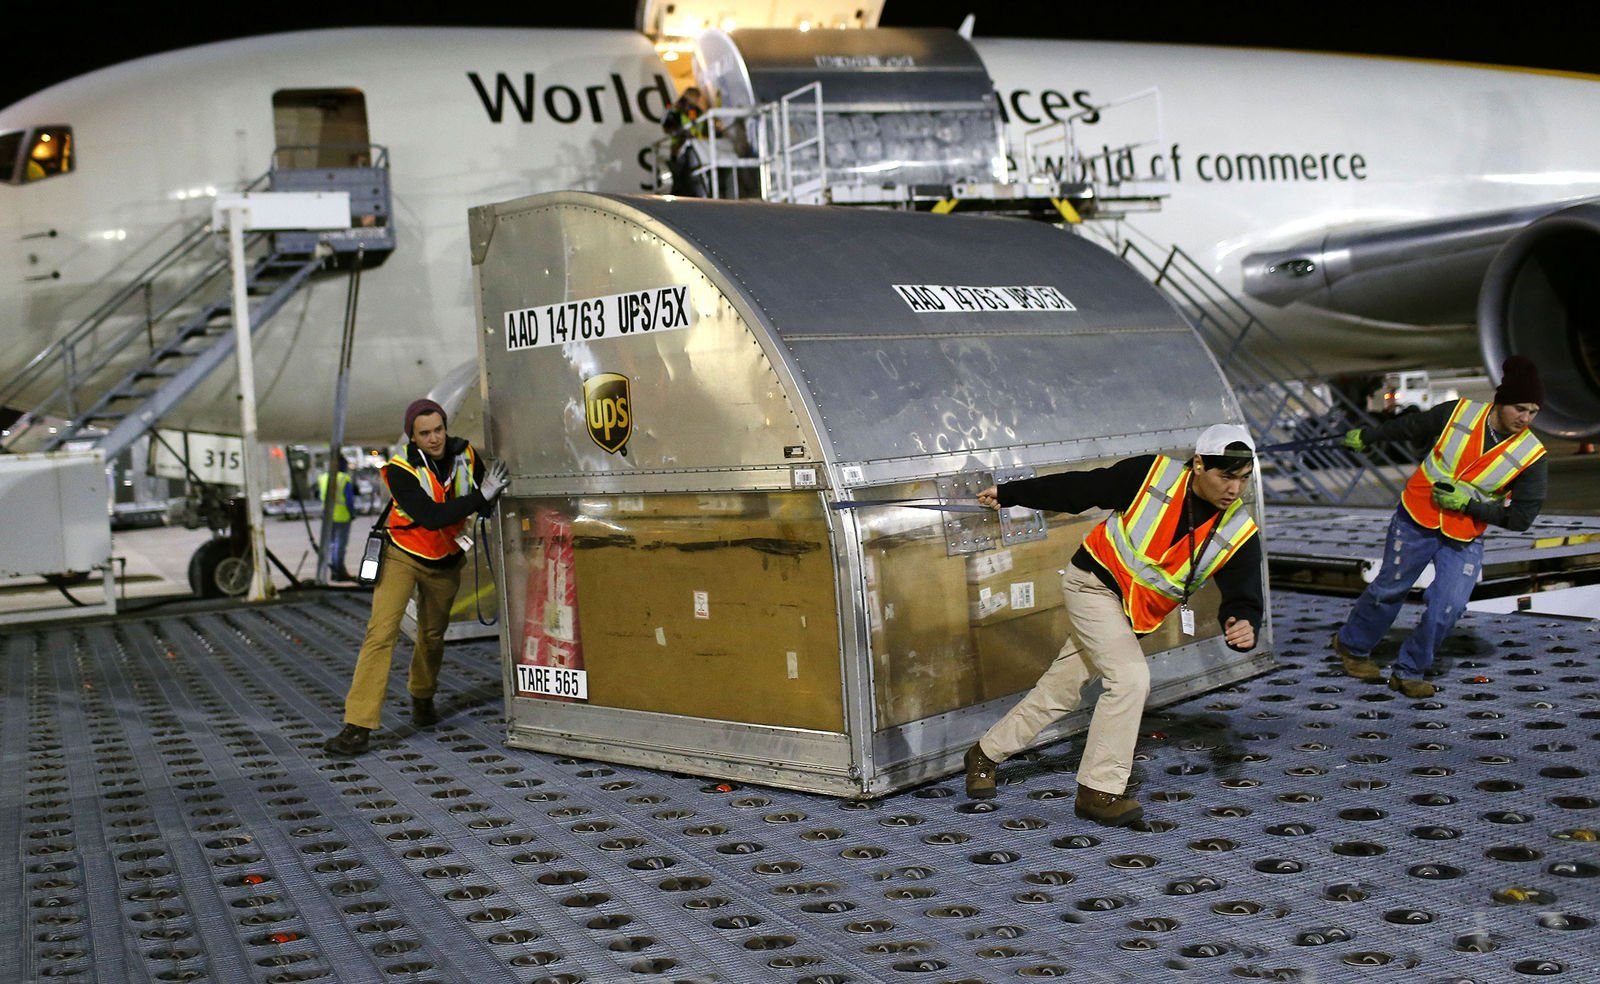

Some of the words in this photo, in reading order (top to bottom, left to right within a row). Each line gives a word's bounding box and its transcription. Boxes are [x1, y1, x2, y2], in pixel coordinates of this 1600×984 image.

[995, 89, 1101, 124] ices
[1151, 143, 1181, 182] of
[1196, 150, 1368, 182] commerce
[899, 285, 946, 311] AAD
[940, 286, 1010, 311] 14763
[1002, 286, 1073, 311] UPS/5X
[508, 310, 538, 349] AAD
[546, 299, 605, 343] 14763
[618, 286, 689, 333] UPS/5X
[588, 396, 629, 441] ups
[203, 449, 240, 470] 315
[519, 667, 550, 692] TARE
[555, 670, 580, 696] 565
